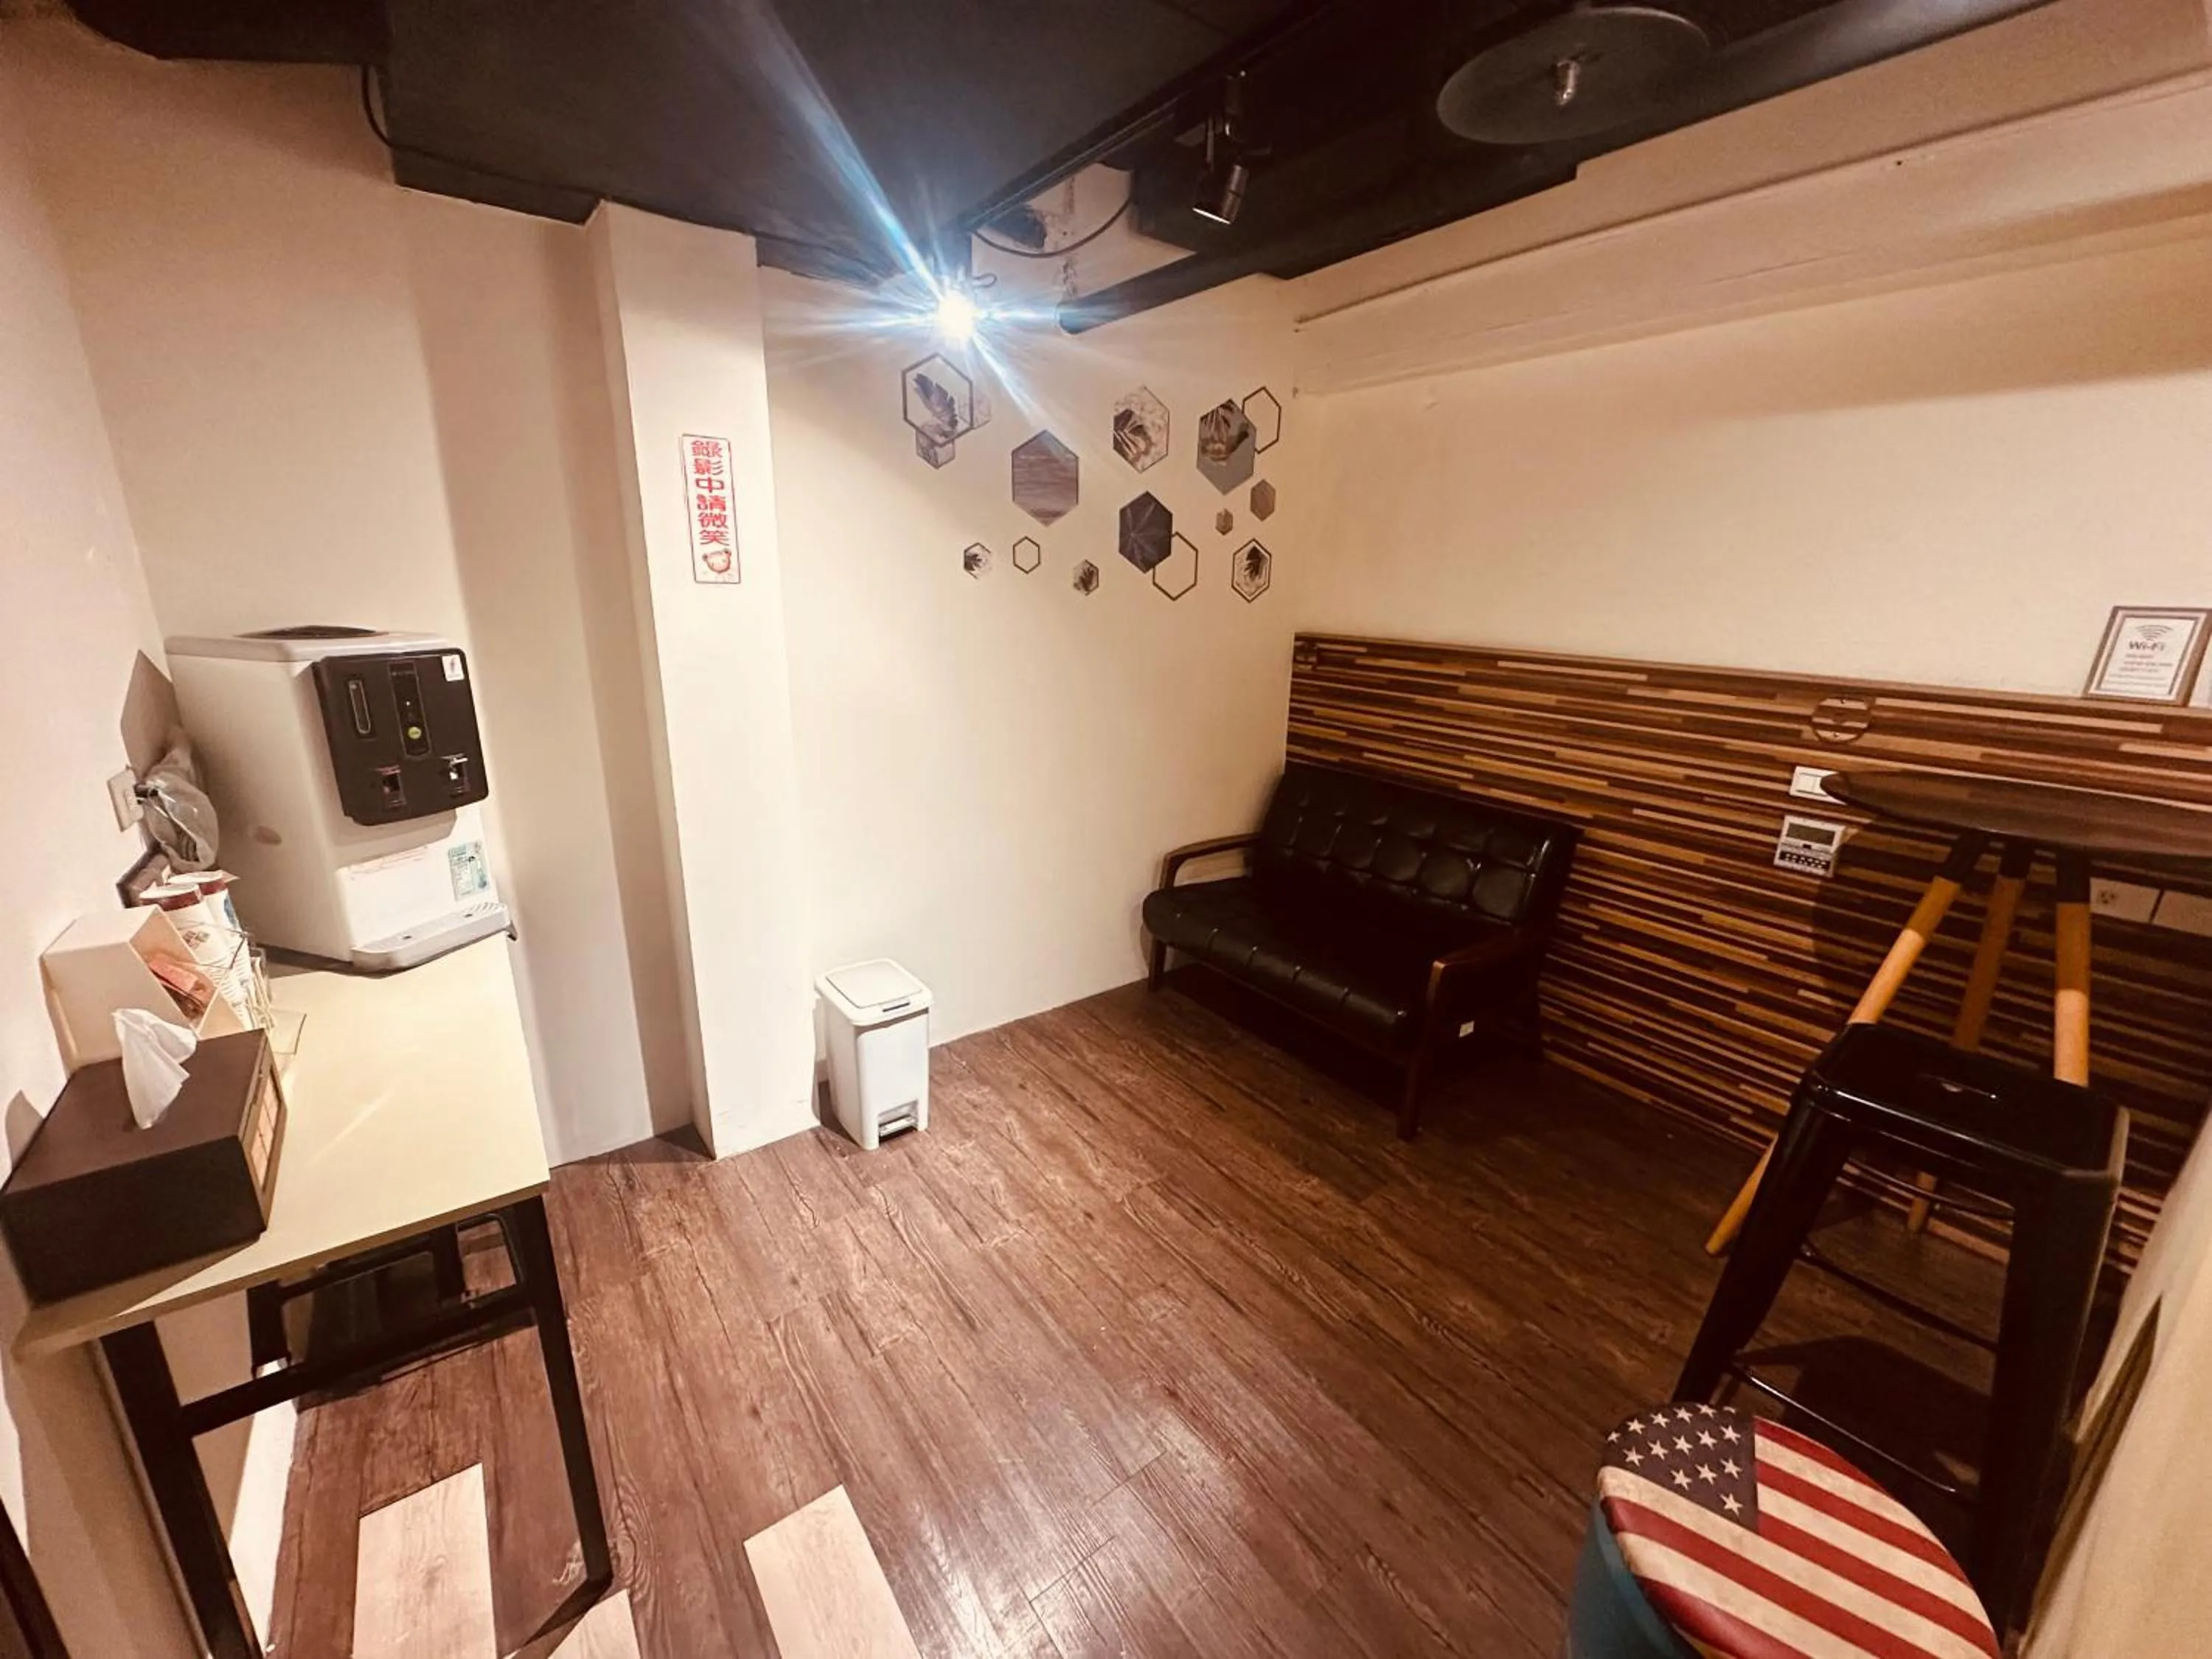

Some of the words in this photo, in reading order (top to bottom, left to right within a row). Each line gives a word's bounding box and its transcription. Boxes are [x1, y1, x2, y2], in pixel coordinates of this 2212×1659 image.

[691, 440, 730, 546] 錄影中請微笑
